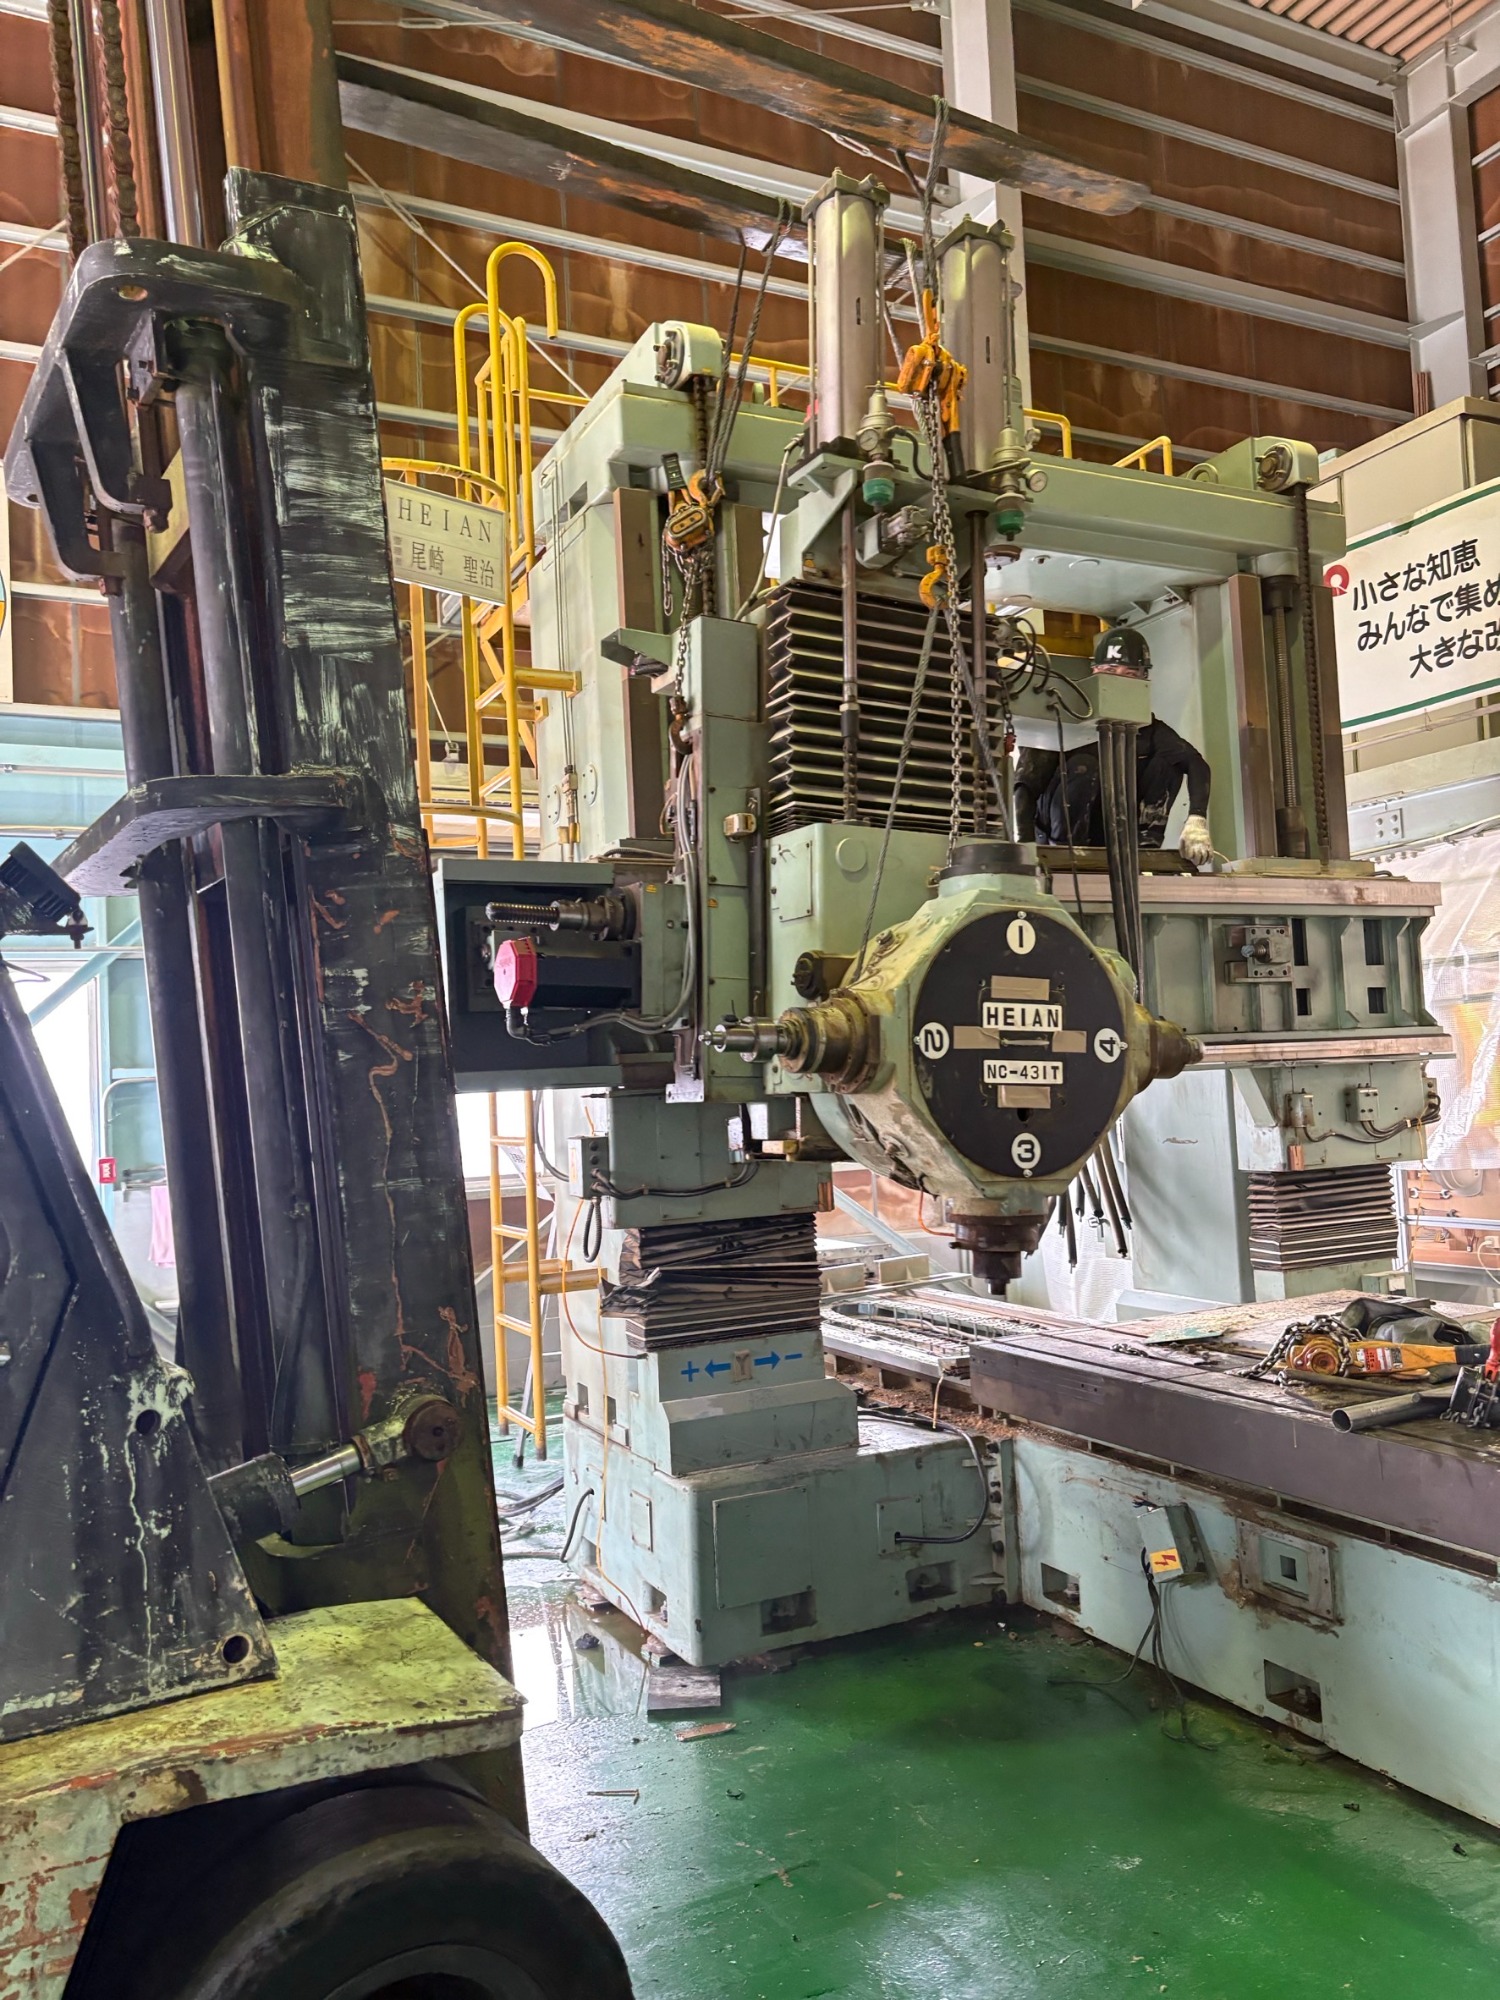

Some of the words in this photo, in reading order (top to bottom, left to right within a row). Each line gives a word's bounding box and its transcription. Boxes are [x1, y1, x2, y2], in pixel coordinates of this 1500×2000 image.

[398, 497, 491, 543] HEIAN
[463, 555, 495, 589] 聖治
[1352, 538, 1481, 612] 小さな知恵
[1106, 645, 1122, 659] K
[986, 1006, 1060, 1028] HEIAN
[924, 1029, 944, 1053] 2
[1098, 1036, 1117, 1058] 4
[987, 1064, 1060, 1080] NC-431T
[1017, 1139, 1036, 1163] 3
